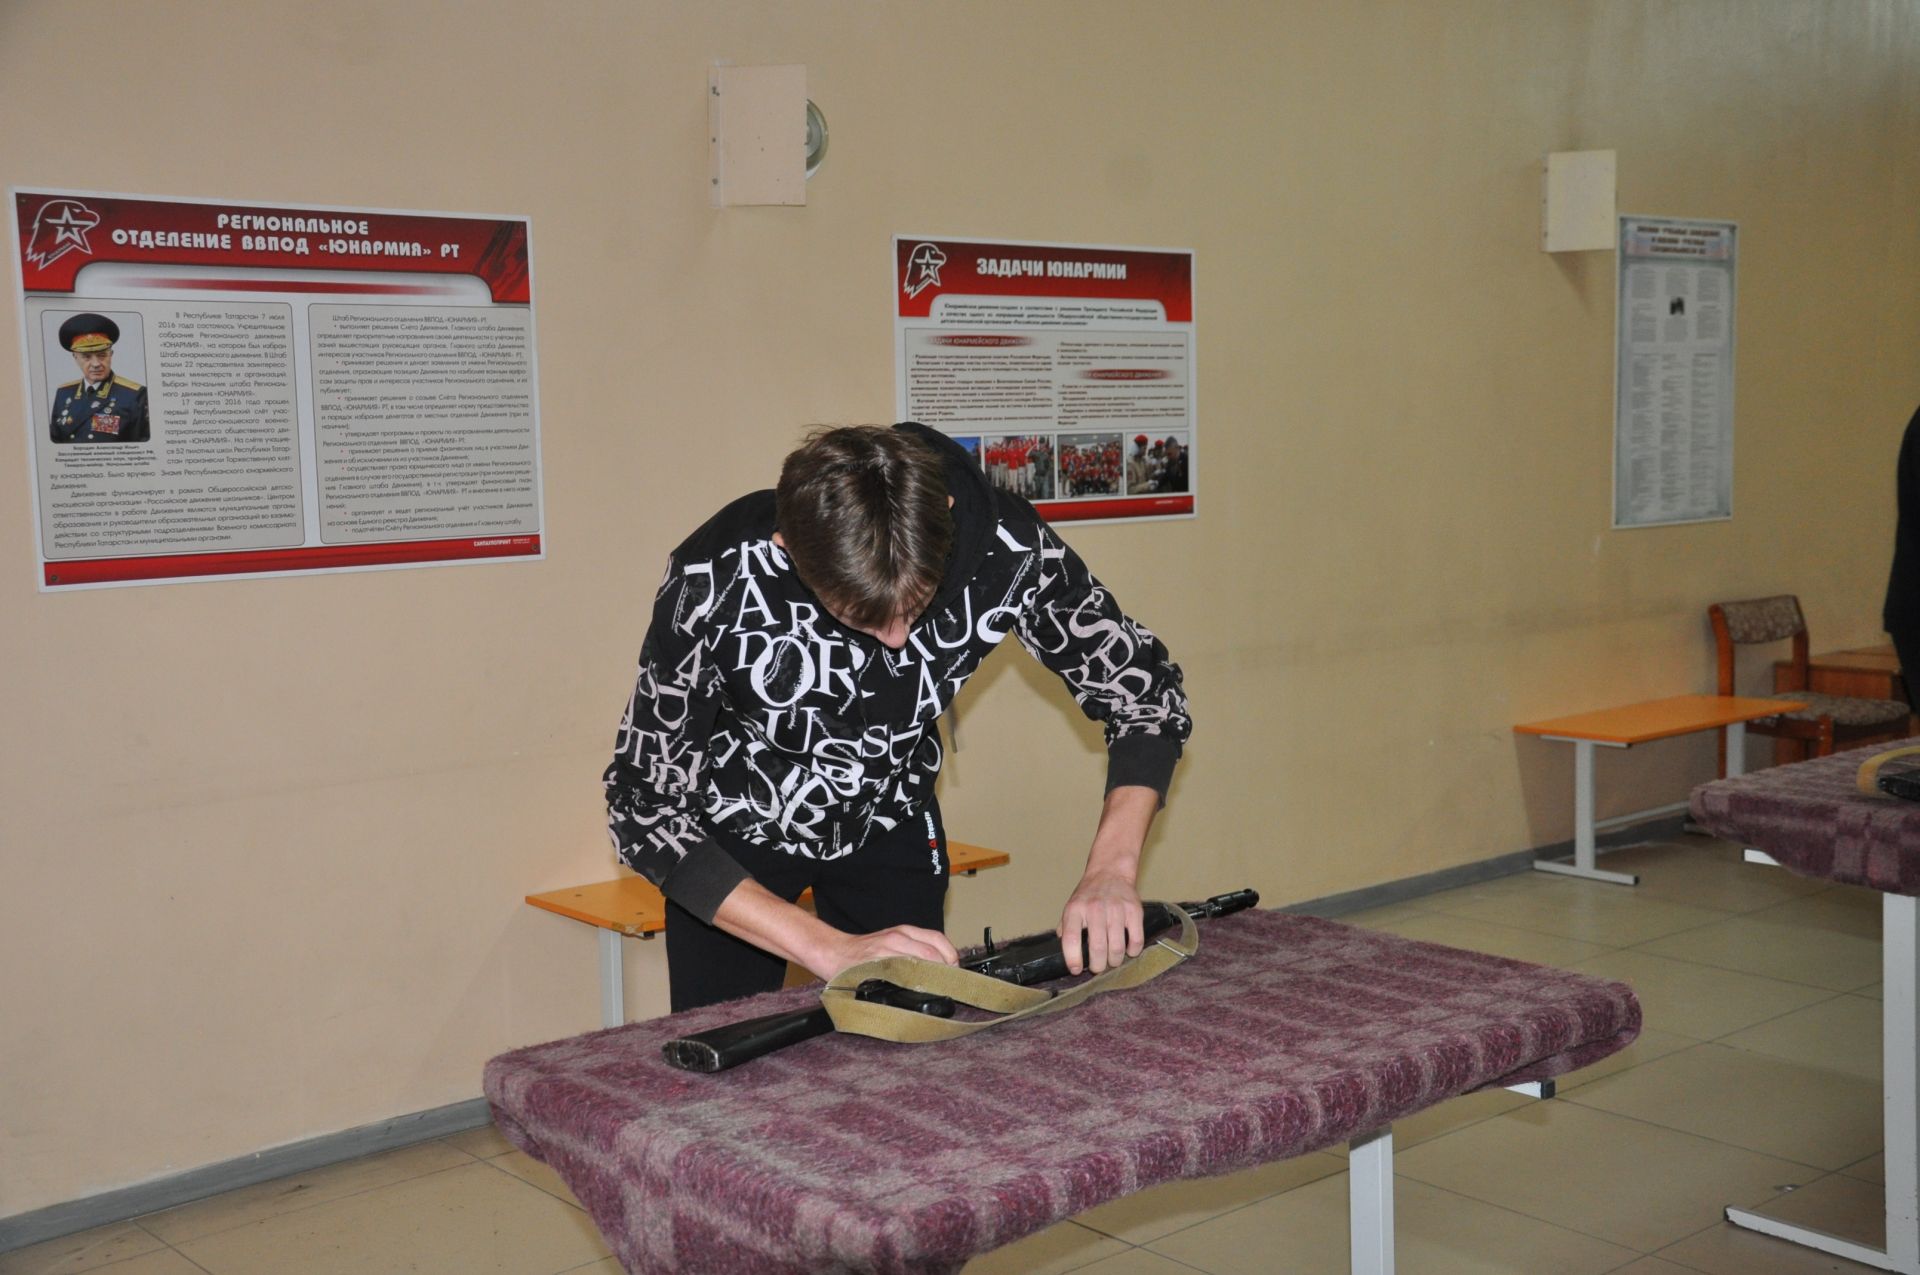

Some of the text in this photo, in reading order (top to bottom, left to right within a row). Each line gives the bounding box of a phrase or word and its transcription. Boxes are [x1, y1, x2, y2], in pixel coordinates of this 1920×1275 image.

[217, 213, 369, 235] РЕГИОНАЛЬНОЕ
[111, 228, 460, 258] ОТДЕЛЕНИЕ ВВПОД «ЮНАРМИЯ» РТ
[976, 257, 1128, 280] ЗАДАЧИ ЮНАРМИИ
